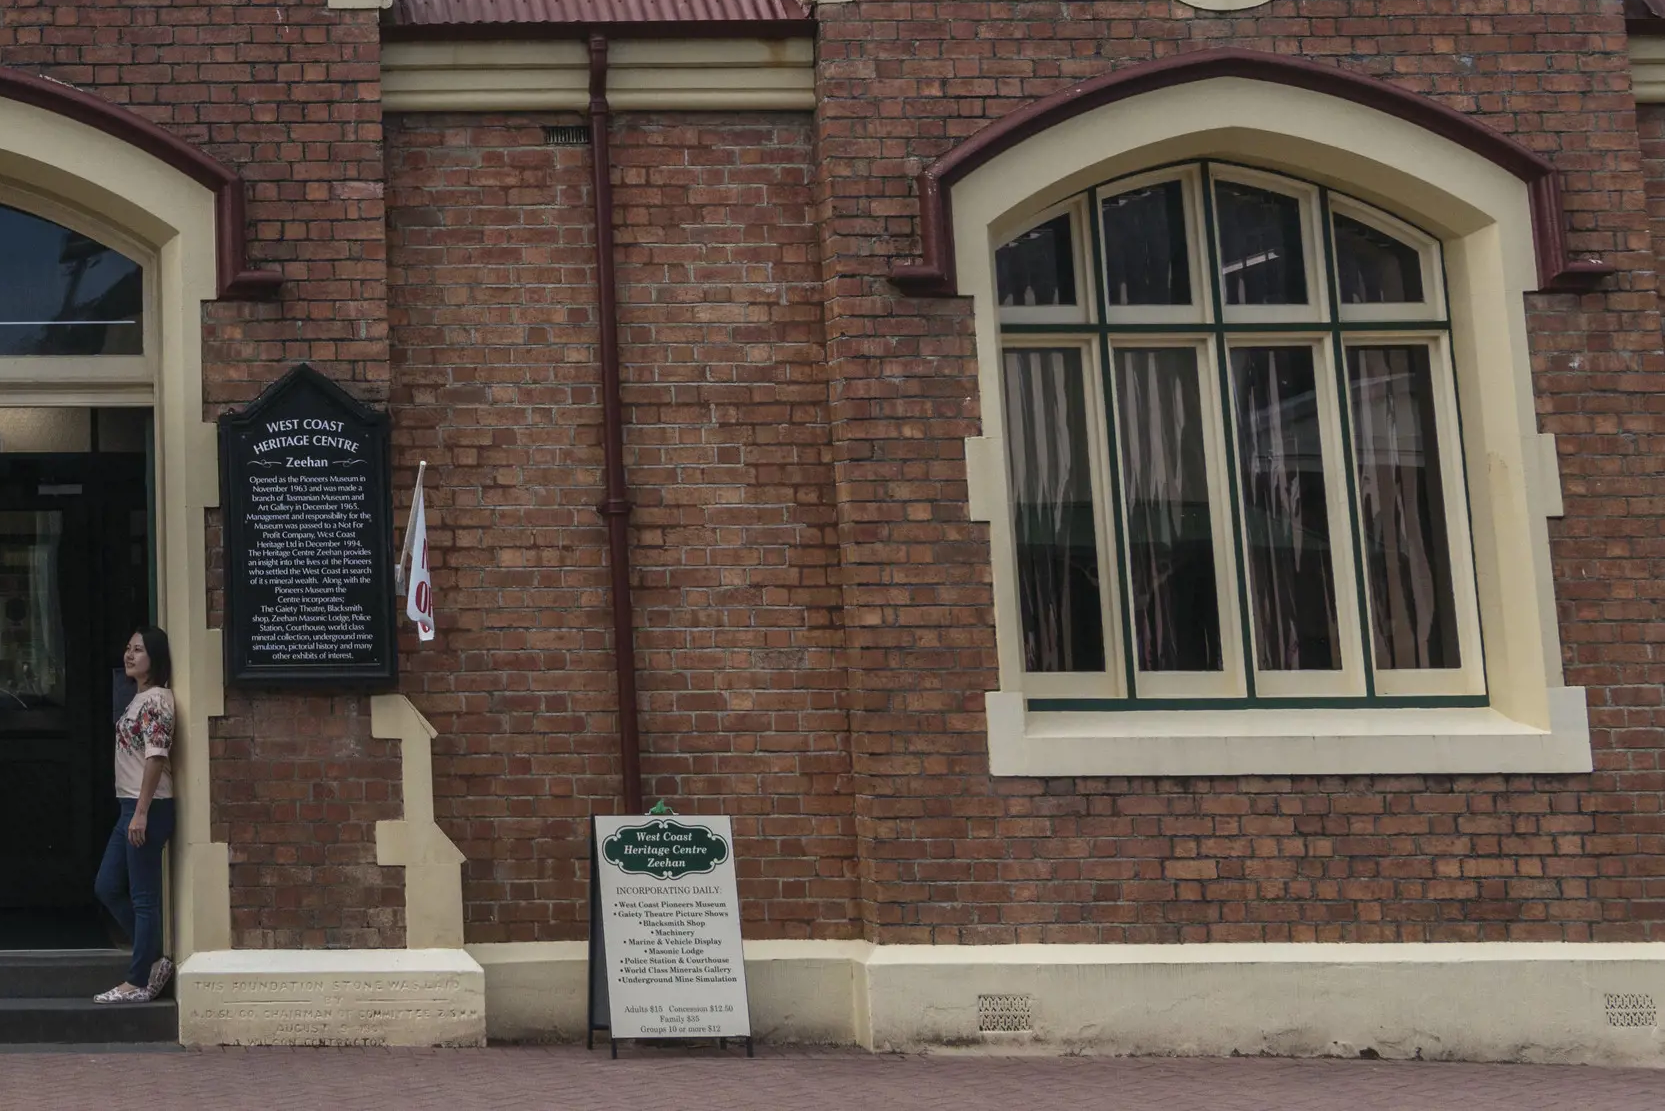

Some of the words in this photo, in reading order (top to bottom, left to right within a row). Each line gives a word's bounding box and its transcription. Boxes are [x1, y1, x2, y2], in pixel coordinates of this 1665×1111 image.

[266, 420, 300, 433] WEST
[303, 419, 344, 432] COAST
[253, 435, 309, 455] HERITAGE
[313, 435, 359, 453] CENTRE
[285, 457, 329, 467] Zeehan
[249, 475, 278, 485] Opened
[288, 475, 298, 484] the
[299, 475, 329, 483] Pioneers
[329, 475, 359, 483] Museum
[360, 474, 366, 482] in
[252, 483, 288, 493] November
[290, 484, 308, 493] 1963
[309, 484, 322, 492] and
[337, 483, 357, 492] made
[251, 494, 276, 502] branch
[276, 493, 283, 502] of
[285, 493, 321, 502] Tasmanian
[352, 492, 364, 501] and
[258, 503, 268, 511] Art
[269, 502, 294, 513] Gallery
[296, 503, 301, 511] in
[302, 502, 338, 511] December
[340, 502, 360, 510] 1965.
[271, 651, 291, 660] other
[291, 651, 318, 660] exhibits
[319, 651, 326, 660] of
[327, 651, 354, 659] interest.
[636, 831, 661, 842] West
[662, 831, 693, 842] Coast
[623, 845, 670, 856] Heritage
[672, 844, 708, 855] Centre
[647, 857, 686, 868] Zeehan
[615, 886, 691, 895] INCORPORATING
[618, 901, 637, 909] West
[637, 900, 660, 909] Coast
[660, 900, 694, 909] Pioneers
[694, 900, 727, 908] Museum
[617, 910, 643, 920] Gaiety
[643, 910, 674, 918] Theatre
[675, 909, 703, 918] Picture
[704, 909, 729, 917] Shows
[642, 919, 686, 927] Blacksmith
[686, 919, 706, 928] Shop
[655, 928, 695, 938] Machinery
[628, 938, 656, 946] Marine
[657, 938, 662, 946] &
[664, 937, 693, 946] Vehicle
[694, 937, 722, 947] Display
[648, 947, 680, 955] Masonic
[681, 947, 705, 956] Lodge
[624, 957, 648, 965] Police
[649, 957, 677, 965] Station
[678, 956, 684, 964] &
[685, 956, 730, 964] Courthouse
[647, 966, 669, 974] Class
[669, 966, 703, 974] Minerals
[703, 966, 732, 975] Gallery
[621, 975, 674, 985] Underground
[674, 975, 695, 983] Mine
[695, 975, 738, 983] Simulation
[623, 1005, 649, 1014] Adults
[650, 1004, 663, 1014] $15
[668, 1004, 709, 1013] Concession
[659, 1014, 685, 1025] Family
[687, 1014, 700, 1023] $35
[639, 1025, 667, 1035] Groups
[669, 1025, 677, 1033] 10
[708, 1024, 720, 1033] $12
